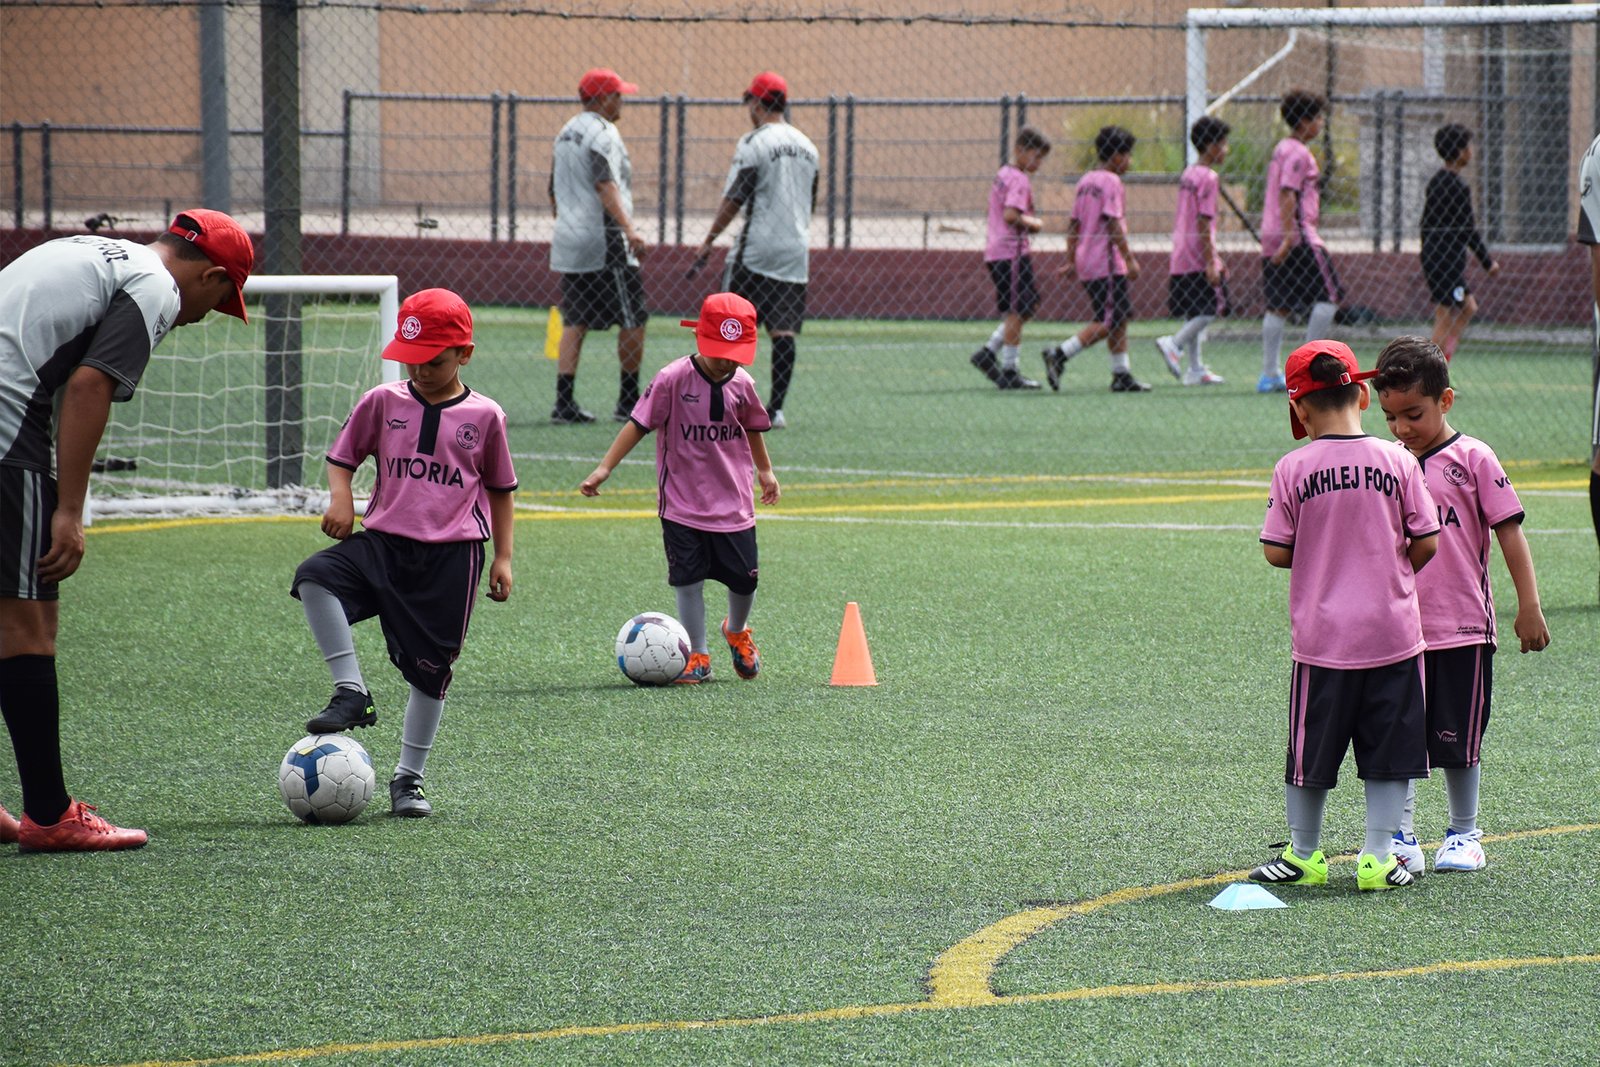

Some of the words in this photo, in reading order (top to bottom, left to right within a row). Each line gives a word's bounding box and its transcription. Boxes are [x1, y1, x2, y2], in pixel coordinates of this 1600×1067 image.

[681, 424, 742, 442] VITORIA
[386, 457, 464, 489] VITORIA
[1296, 466, 1359, 504] LAKHLEJ
[1364, 466, 1400, 501] FOOT
[1436, 730, 1457, 742] Vitoria
